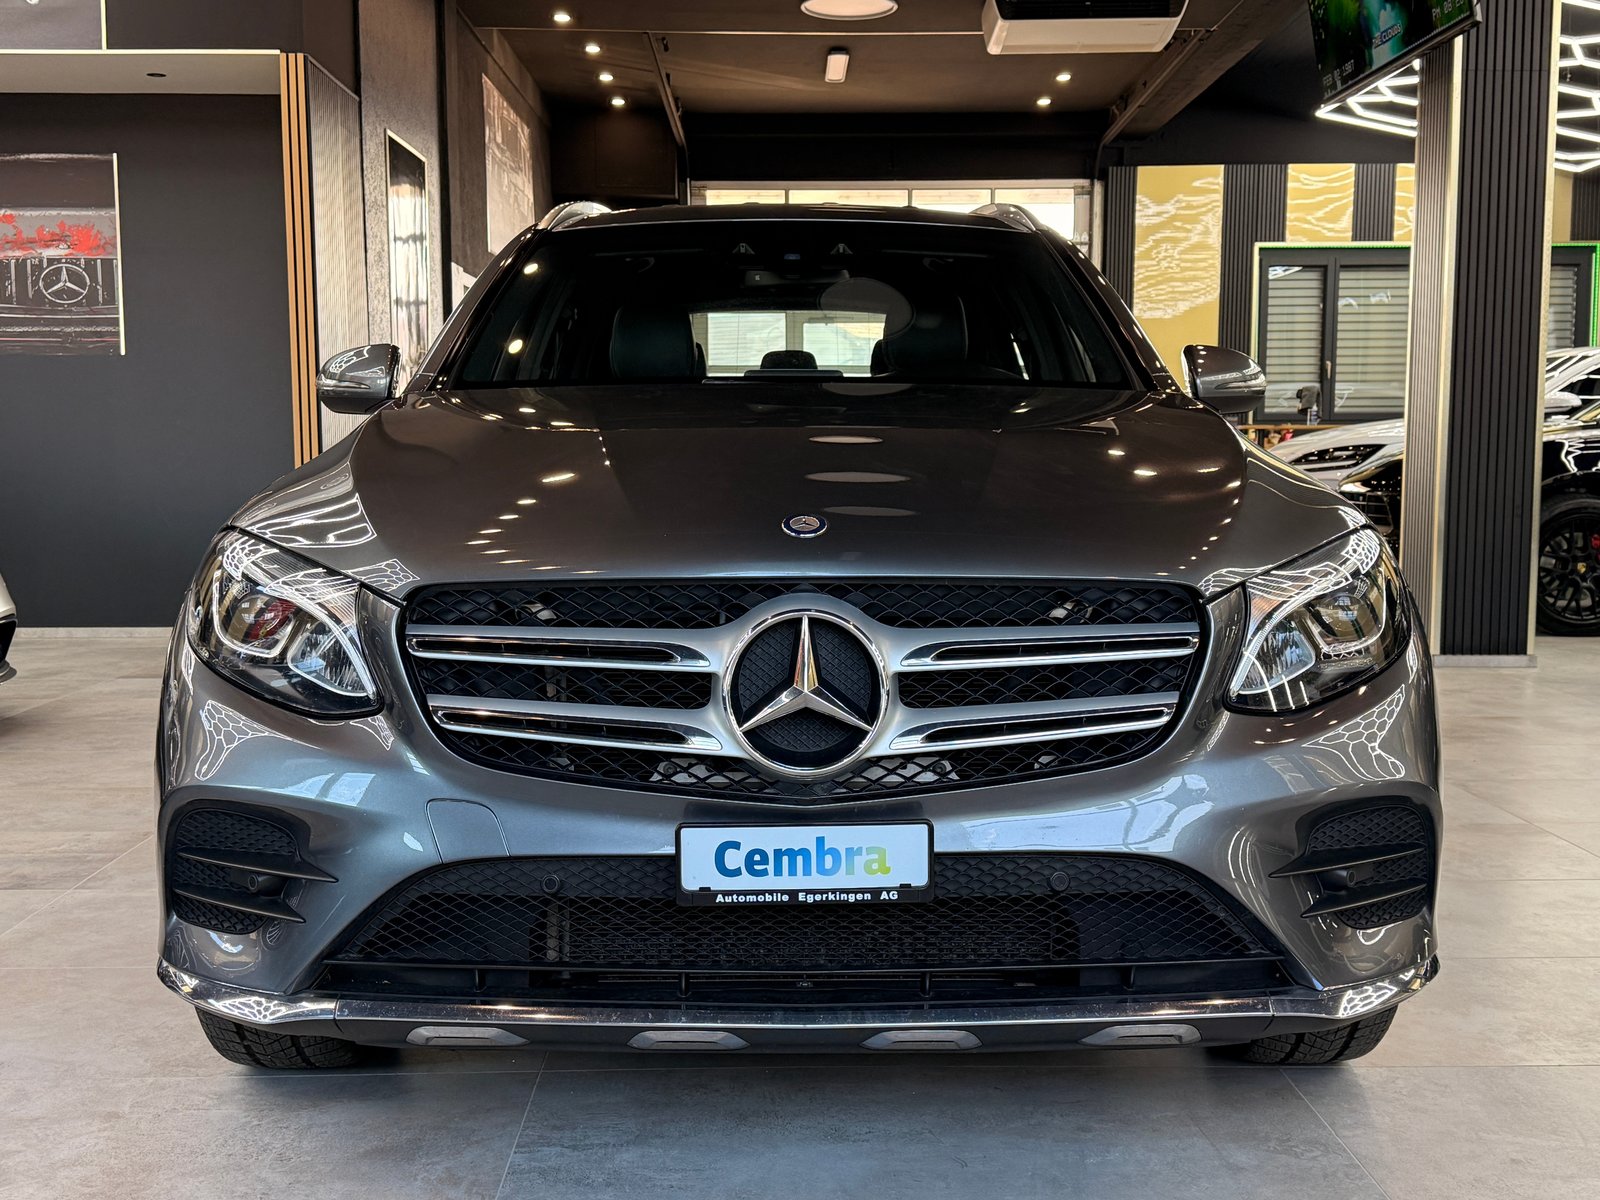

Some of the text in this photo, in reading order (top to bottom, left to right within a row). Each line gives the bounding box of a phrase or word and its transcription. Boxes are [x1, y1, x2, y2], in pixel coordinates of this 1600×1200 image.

[1382, 23, 1402, 41] CLOUDS
[714, 836, 891, 878] Cembra
[715, 890, 899, 903] Automobile Egerkingen AG
